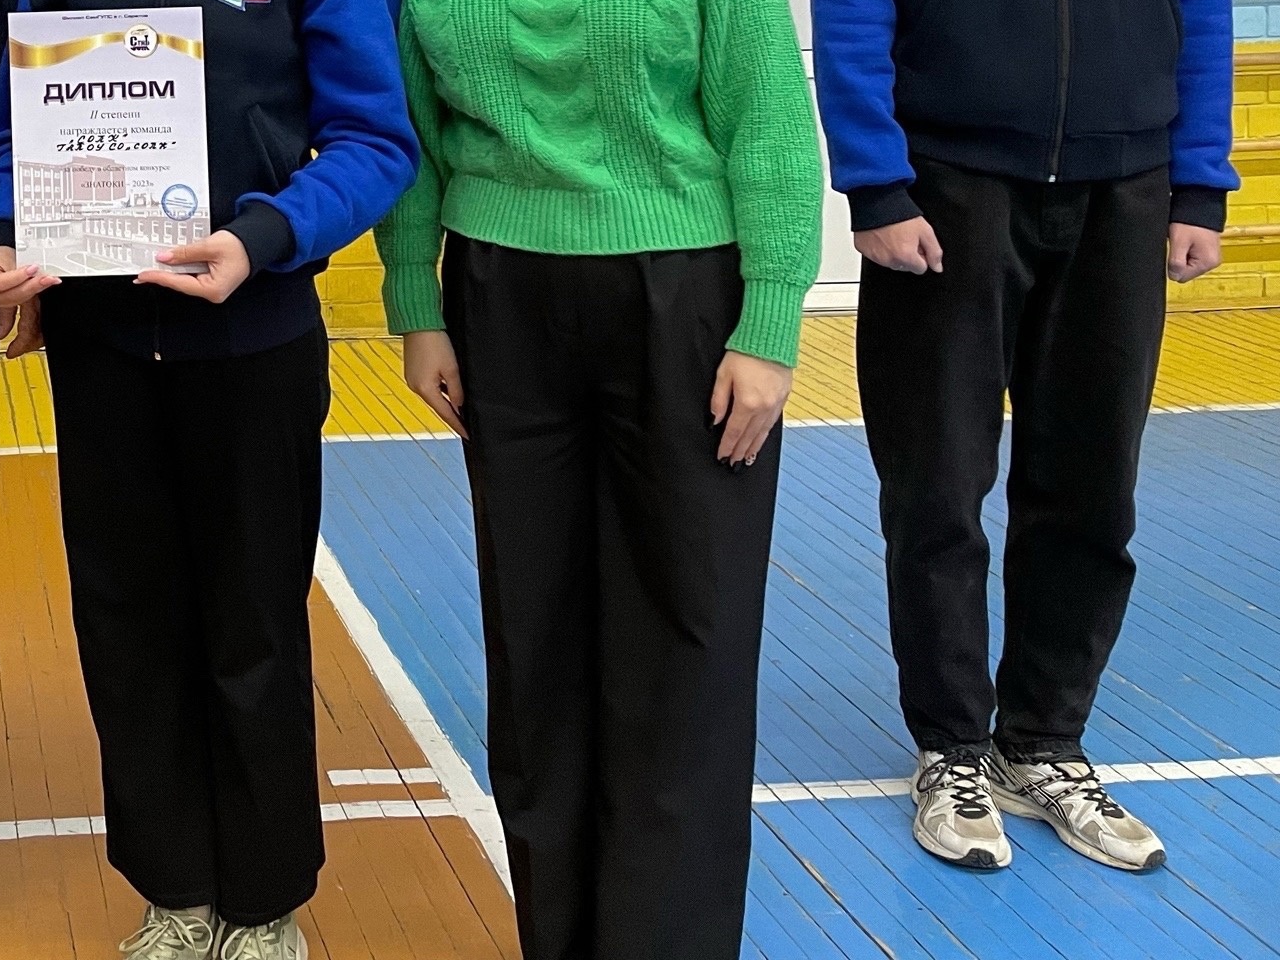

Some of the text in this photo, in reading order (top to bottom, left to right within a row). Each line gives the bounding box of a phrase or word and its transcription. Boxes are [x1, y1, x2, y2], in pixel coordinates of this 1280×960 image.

[43, 80, 175, 105] ДИПЛОМ
[90, 110, 140, 119] II степени
[60, 127, 127, 137] награждается
